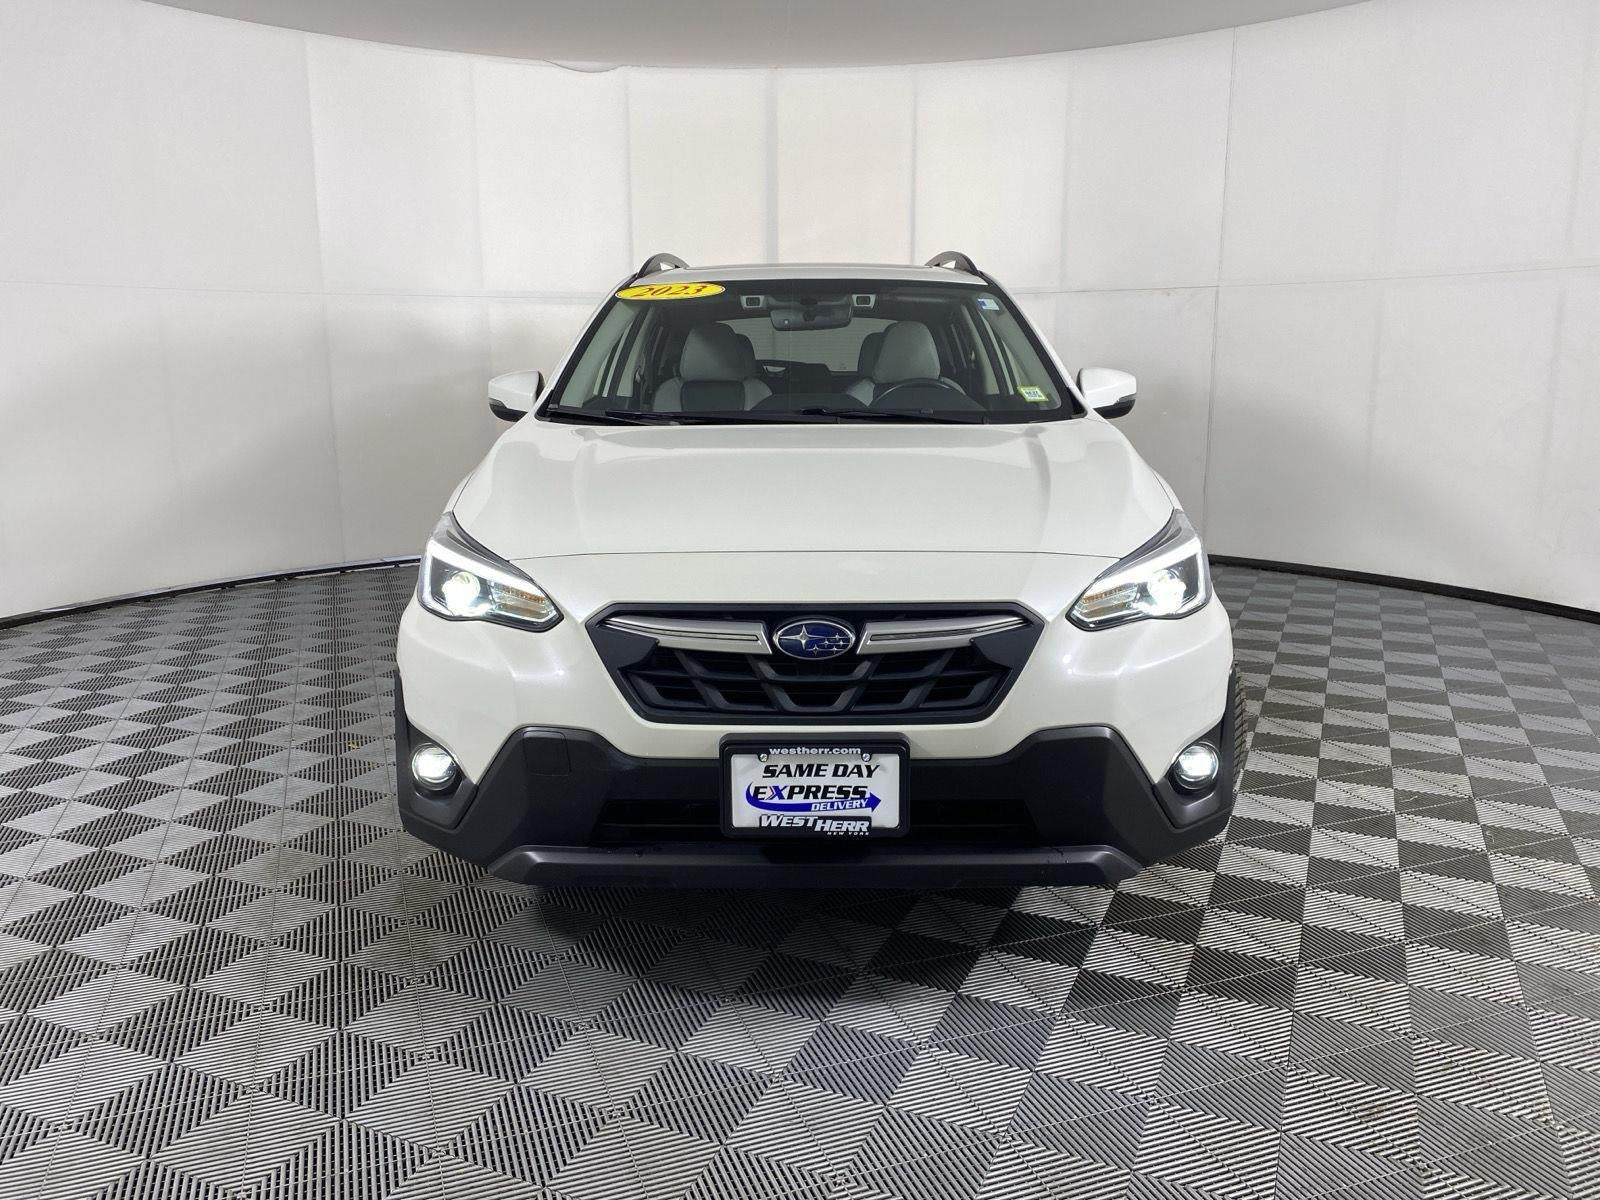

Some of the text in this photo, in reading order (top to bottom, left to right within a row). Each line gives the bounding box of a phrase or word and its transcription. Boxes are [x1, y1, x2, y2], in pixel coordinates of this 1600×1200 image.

[630, 285, 708, 298] 2023
[769, 747, 861, 755] westherr.com
[763, 763, 880, 778] SAME DAY
[753, 785, 868, 800] EXPRESS
[811, 800, 868, 812] DELIVERY
